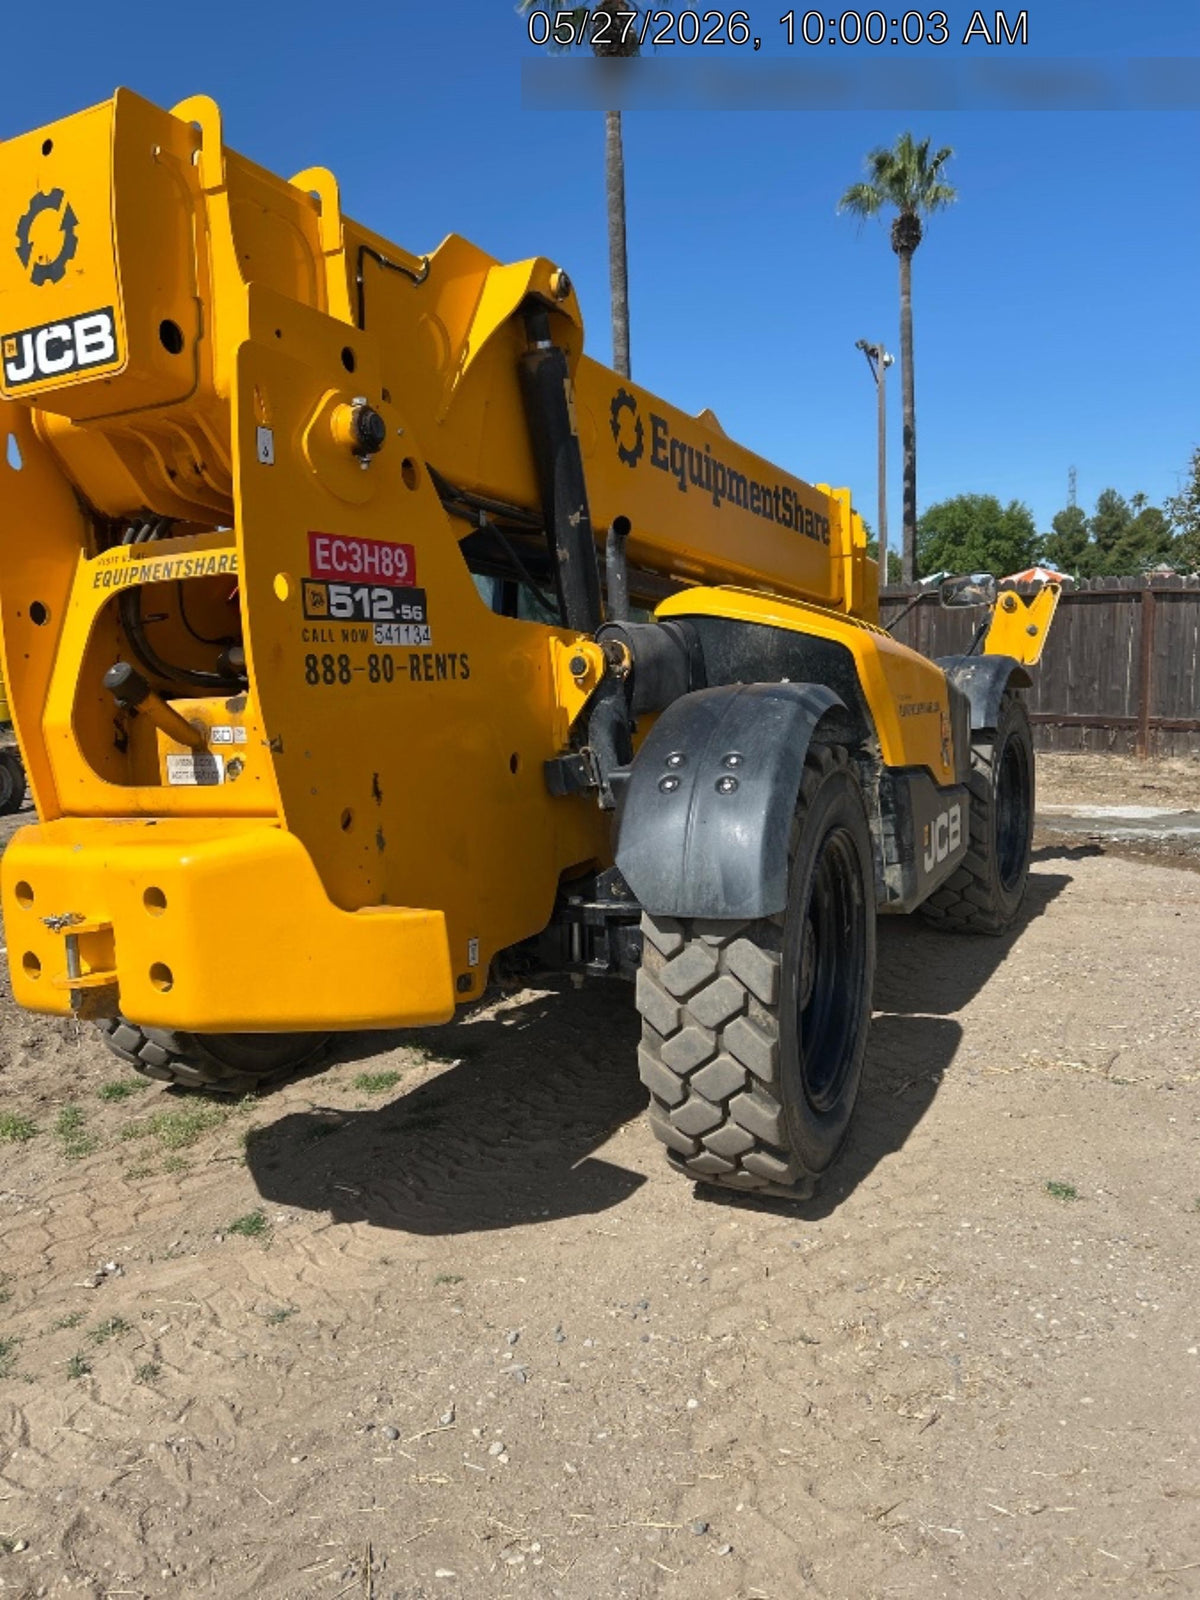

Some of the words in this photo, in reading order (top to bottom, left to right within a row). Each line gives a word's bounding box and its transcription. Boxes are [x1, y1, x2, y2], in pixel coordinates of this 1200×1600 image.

[6, 313, 115, 381] JCB
[649, 412, 831, 546] EquipmentShare
[93, 553, 239, 589] EQUIPMENTSHARE
[315, 537, 408, 578] EC3H89
[302, 628, 336, 643] CALL
[341, 628, 369, 643] NOW
[374, 624, 431, 646] 541134
[305, 652, 471, 686] 888-80-RENTS
[924, 803, 961, 874] JCB
